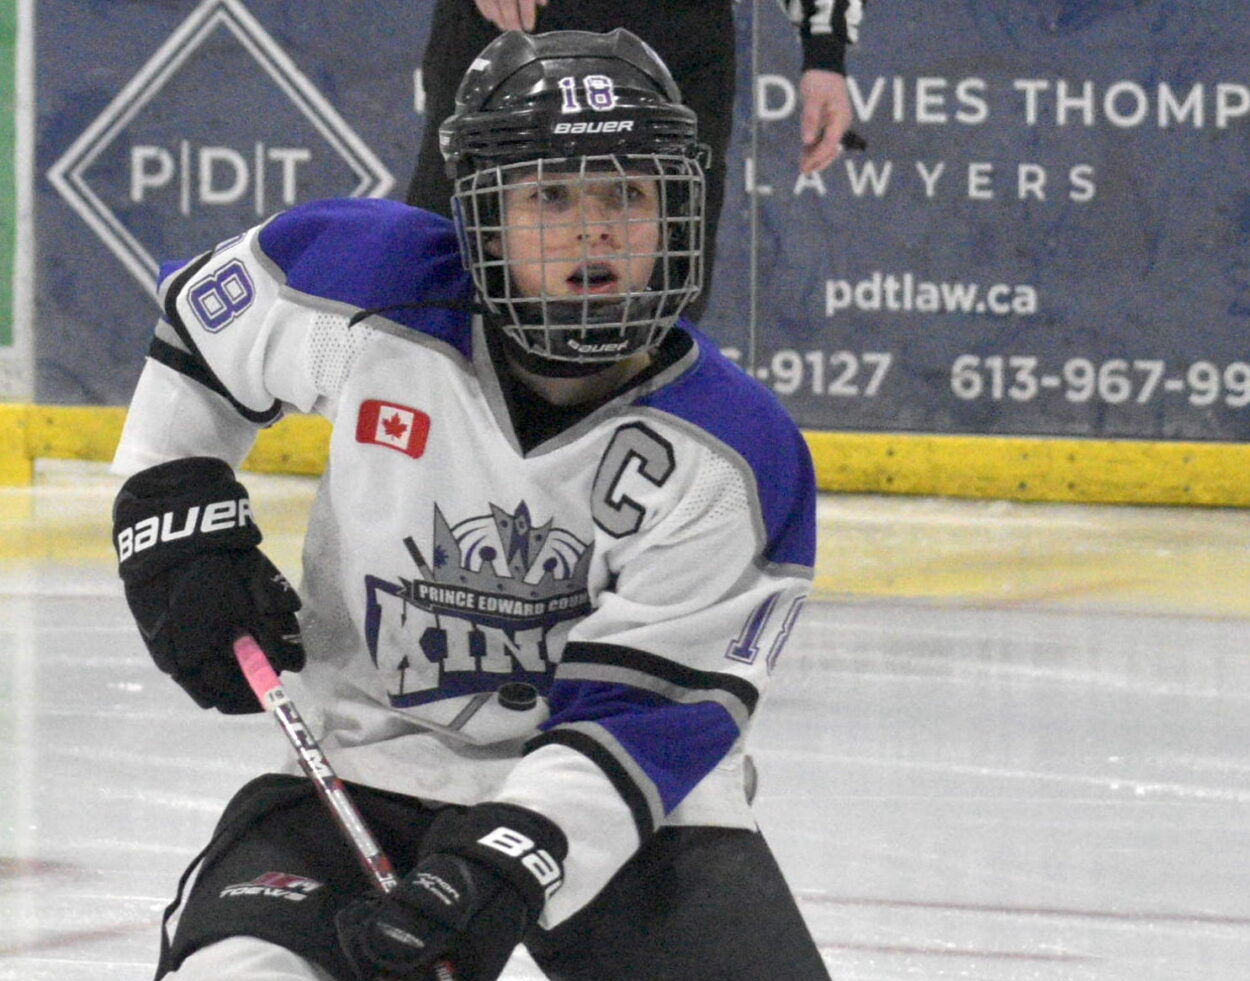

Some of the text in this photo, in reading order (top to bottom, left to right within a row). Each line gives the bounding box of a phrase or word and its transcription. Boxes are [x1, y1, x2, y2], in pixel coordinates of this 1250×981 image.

[558, 75, 616, 114] 18
[756, 73, 990, 124] DVIES
[744, 157, 1096, 201] LAWYERS
[825, 272, 1039, 316] pdtlaw.ca
[589, 420, 677, 539] C
[418, 583, 475, 609] PRINCE
[477, 594, 546, 617] EDWARD
